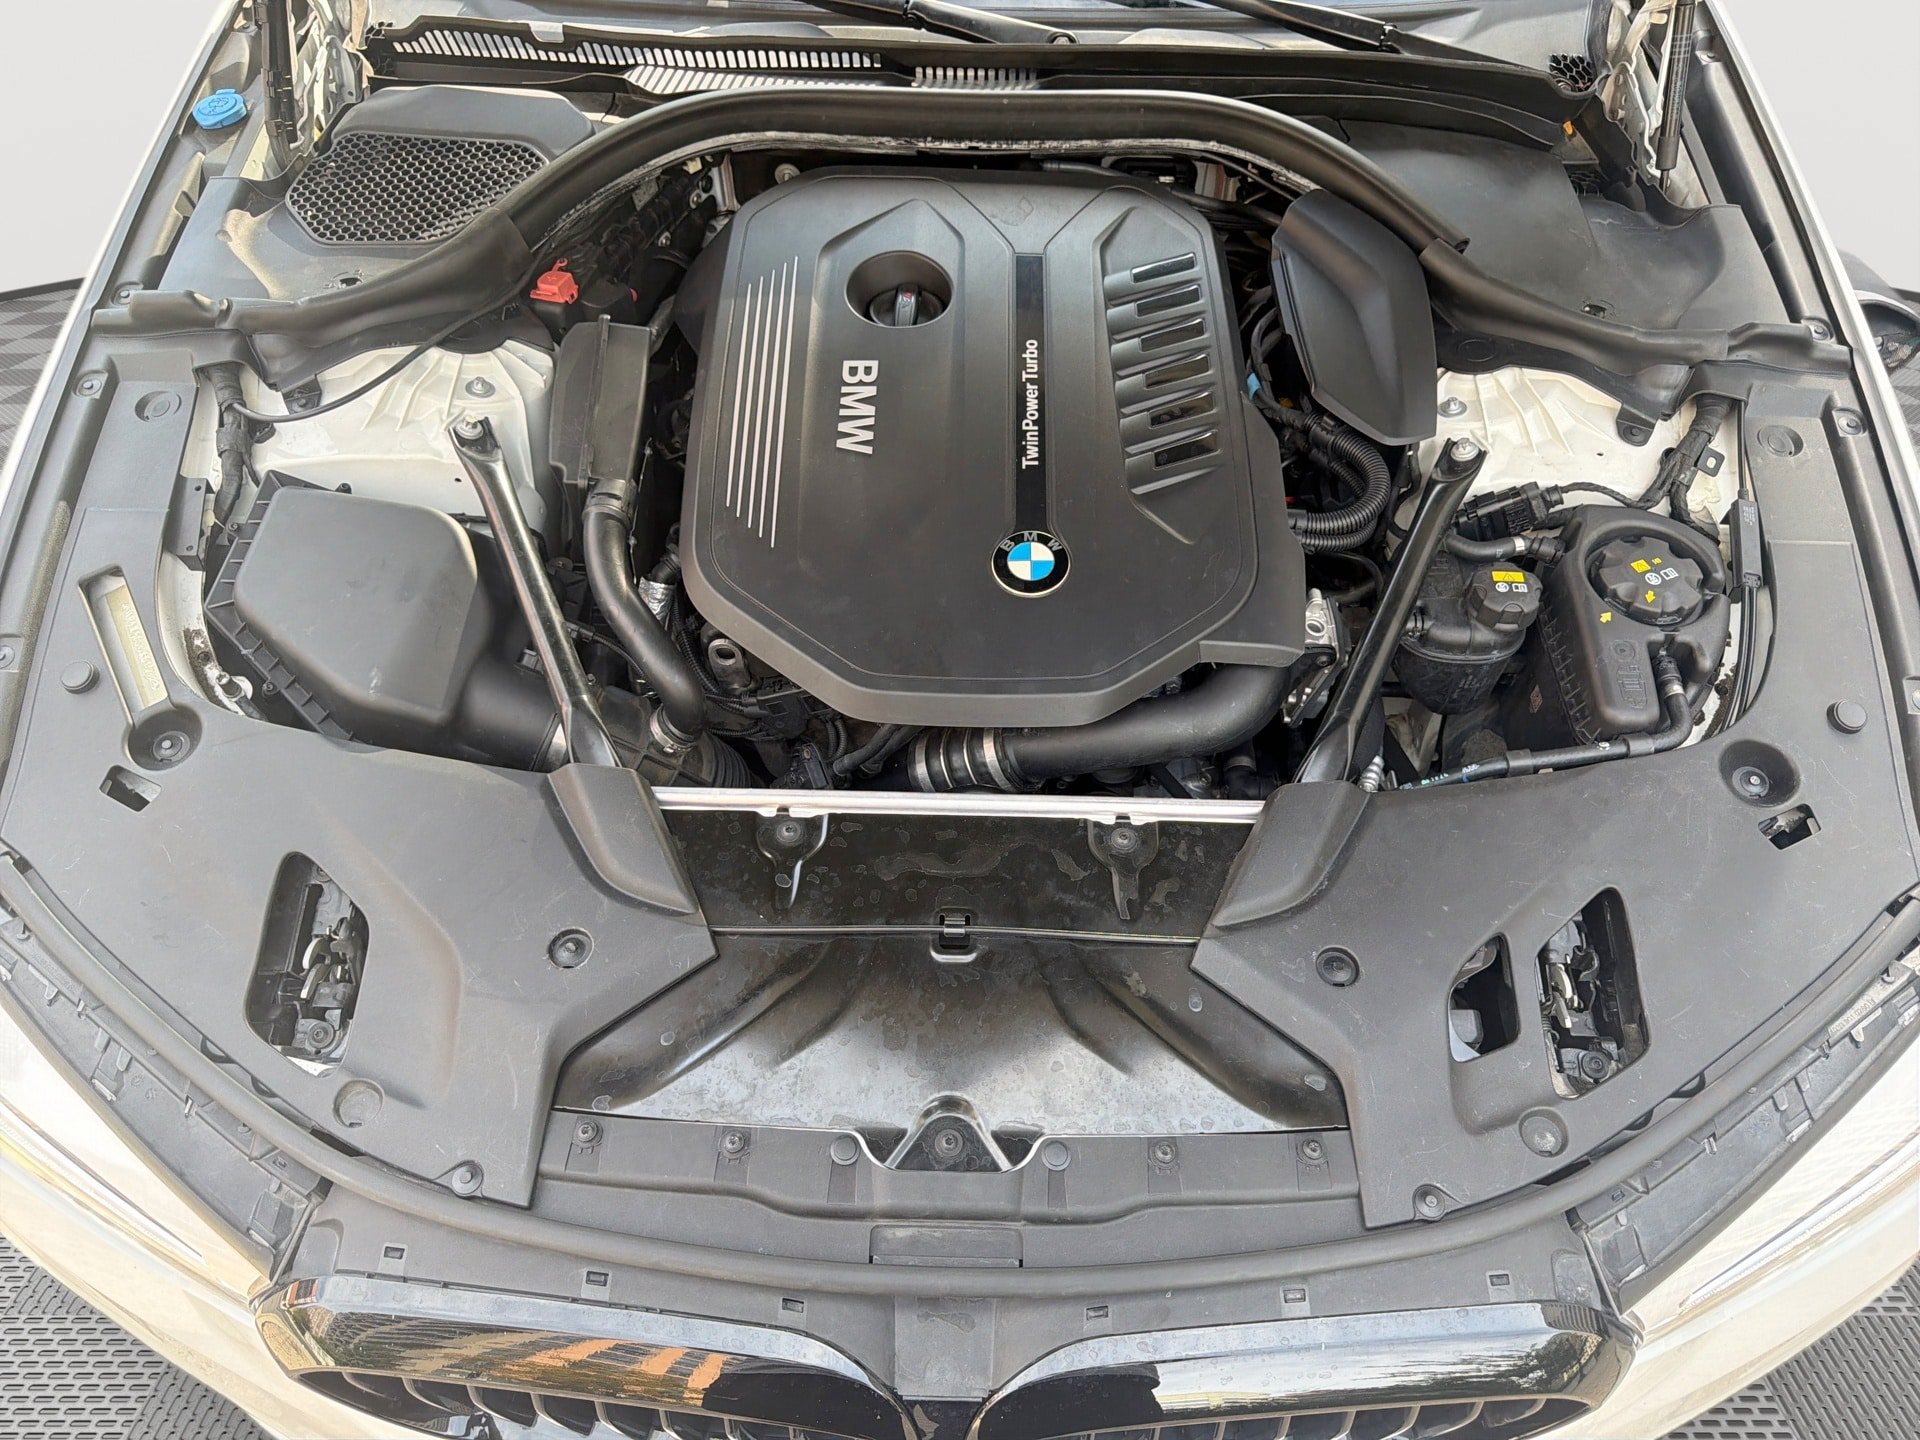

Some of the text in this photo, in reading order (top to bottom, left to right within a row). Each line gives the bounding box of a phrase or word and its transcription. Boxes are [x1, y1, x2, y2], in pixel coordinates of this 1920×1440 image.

[836, 360, 879, 455] BMW
[1021, 339, 1039, 470] TwinPower Turbo
[1000, 531, 1063, 552] BMW
